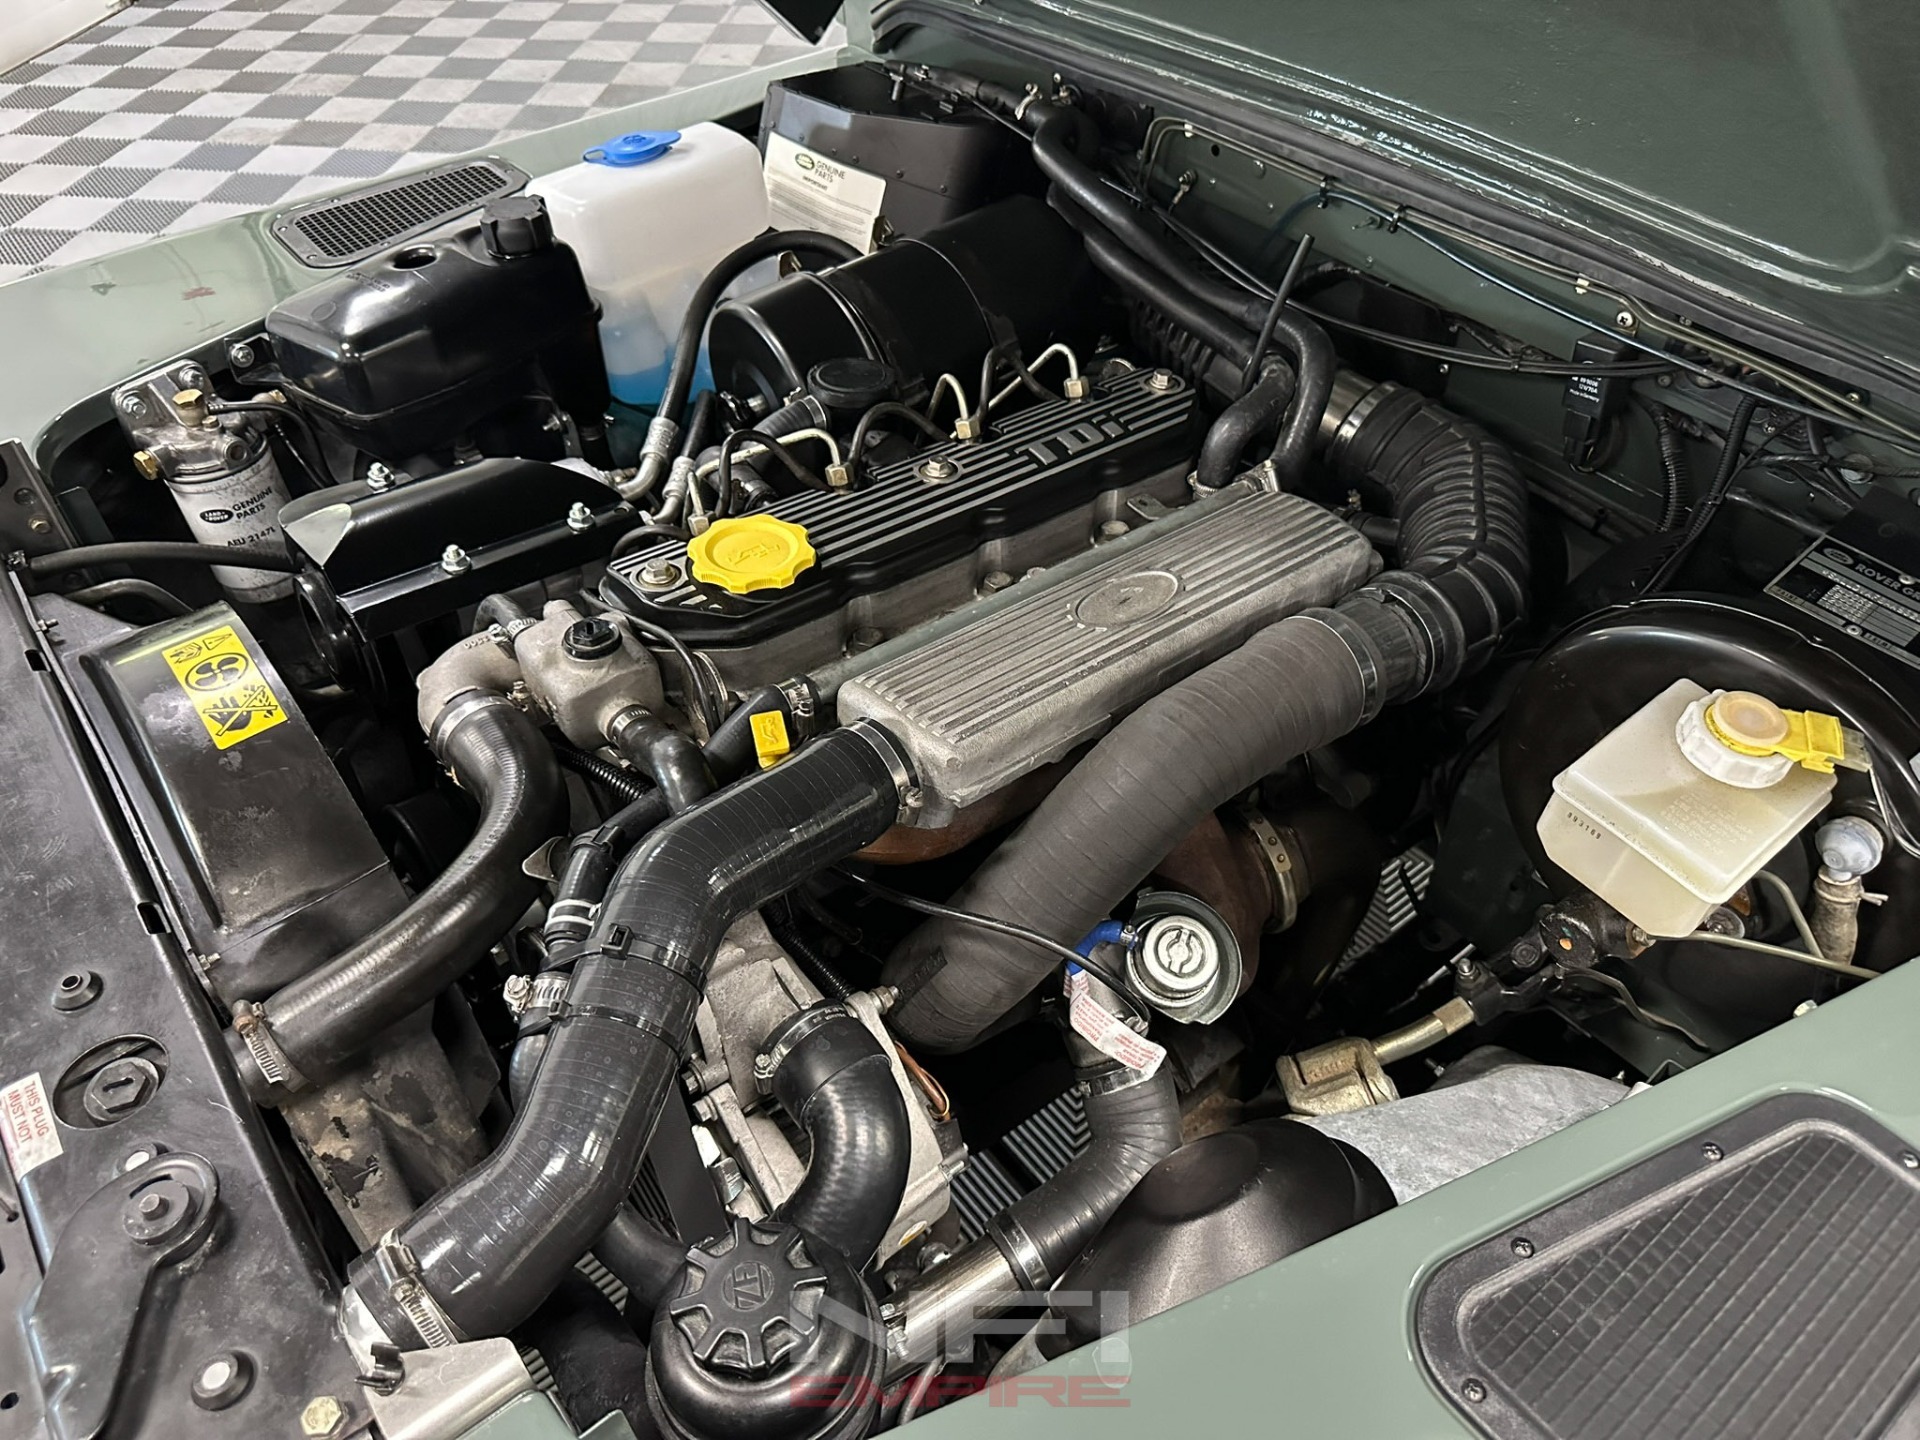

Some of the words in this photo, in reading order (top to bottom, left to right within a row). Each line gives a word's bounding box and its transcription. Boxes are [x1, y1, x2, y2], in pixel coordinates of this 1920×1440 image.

[814, 168, 834, 183] PARTS
[1014, 413, 1125, 467] TDi
[236, 502, 266, 520] PARTS
[1855, 563, 1901, 591] ROVER
[8, 1089, 26, 1120] MUST
[24, 1080, 41, 1107] THIS
[16, 1119, 33, 1144] NOT
[31, 1106, 50, 1137] PLUG
[733, 1262, 765, 1308] ZF
